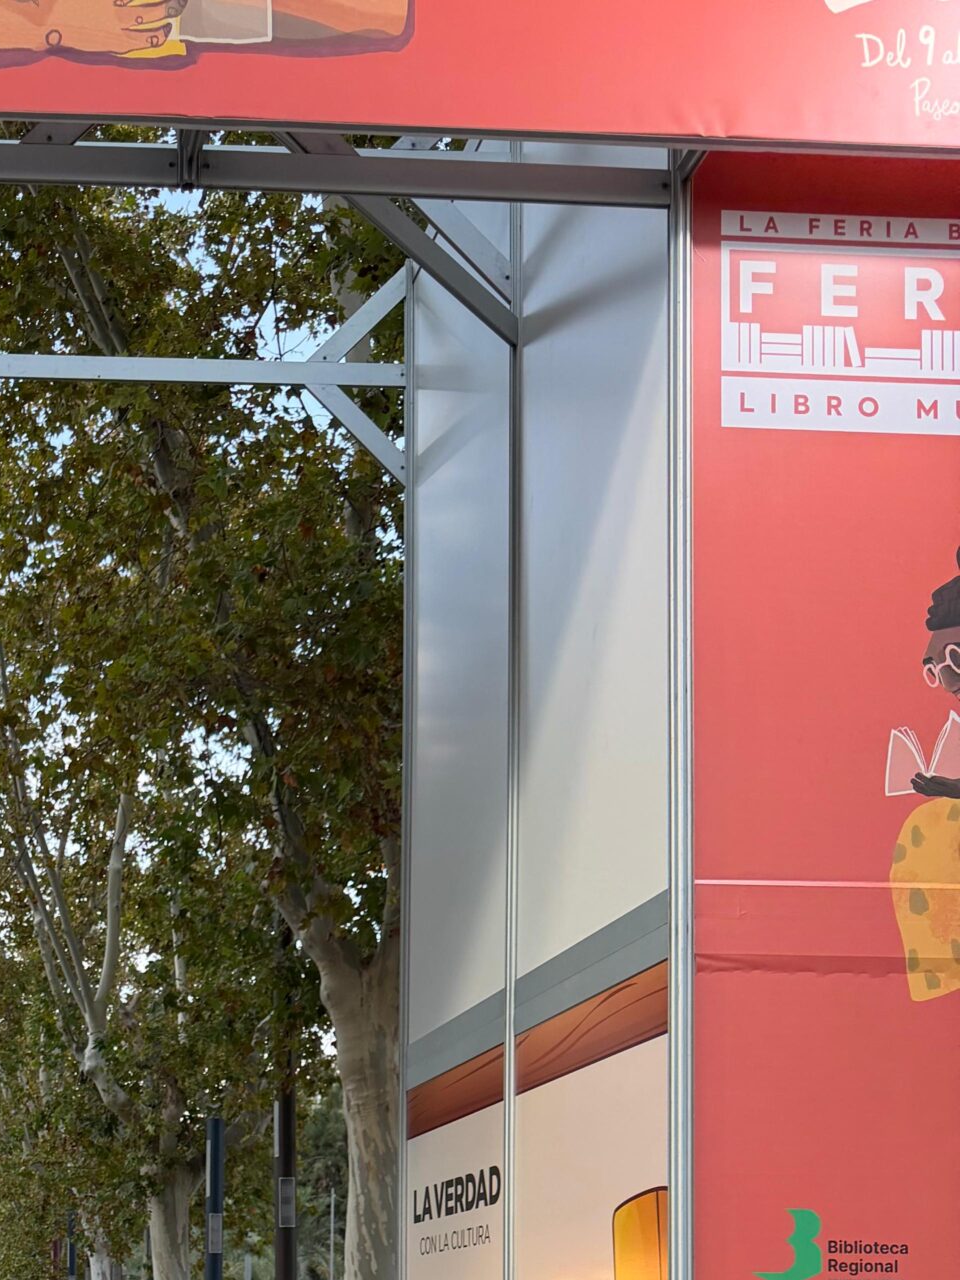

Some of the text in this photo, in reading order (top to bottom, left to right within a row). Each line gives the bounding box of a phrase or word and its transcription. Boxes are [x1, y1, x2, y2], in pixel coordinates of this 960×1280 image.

[854, 28, 911, 68] Del
[919, 25, 935, 66] 9
[740, 214, 779, 235] LA
[808, 218, 919, 240] FERIA
[739, 260, 946, 321] FER
[740, 392, 960, 421] LIBRO M
[413, 1165, 501, 1224] LA VERDAD
[420, 1223, 491, 1256] CON LA CULTURA
[827, 1240, 909, 1255] Biblioteca
[827, 1259, 899, 1276] Regional
